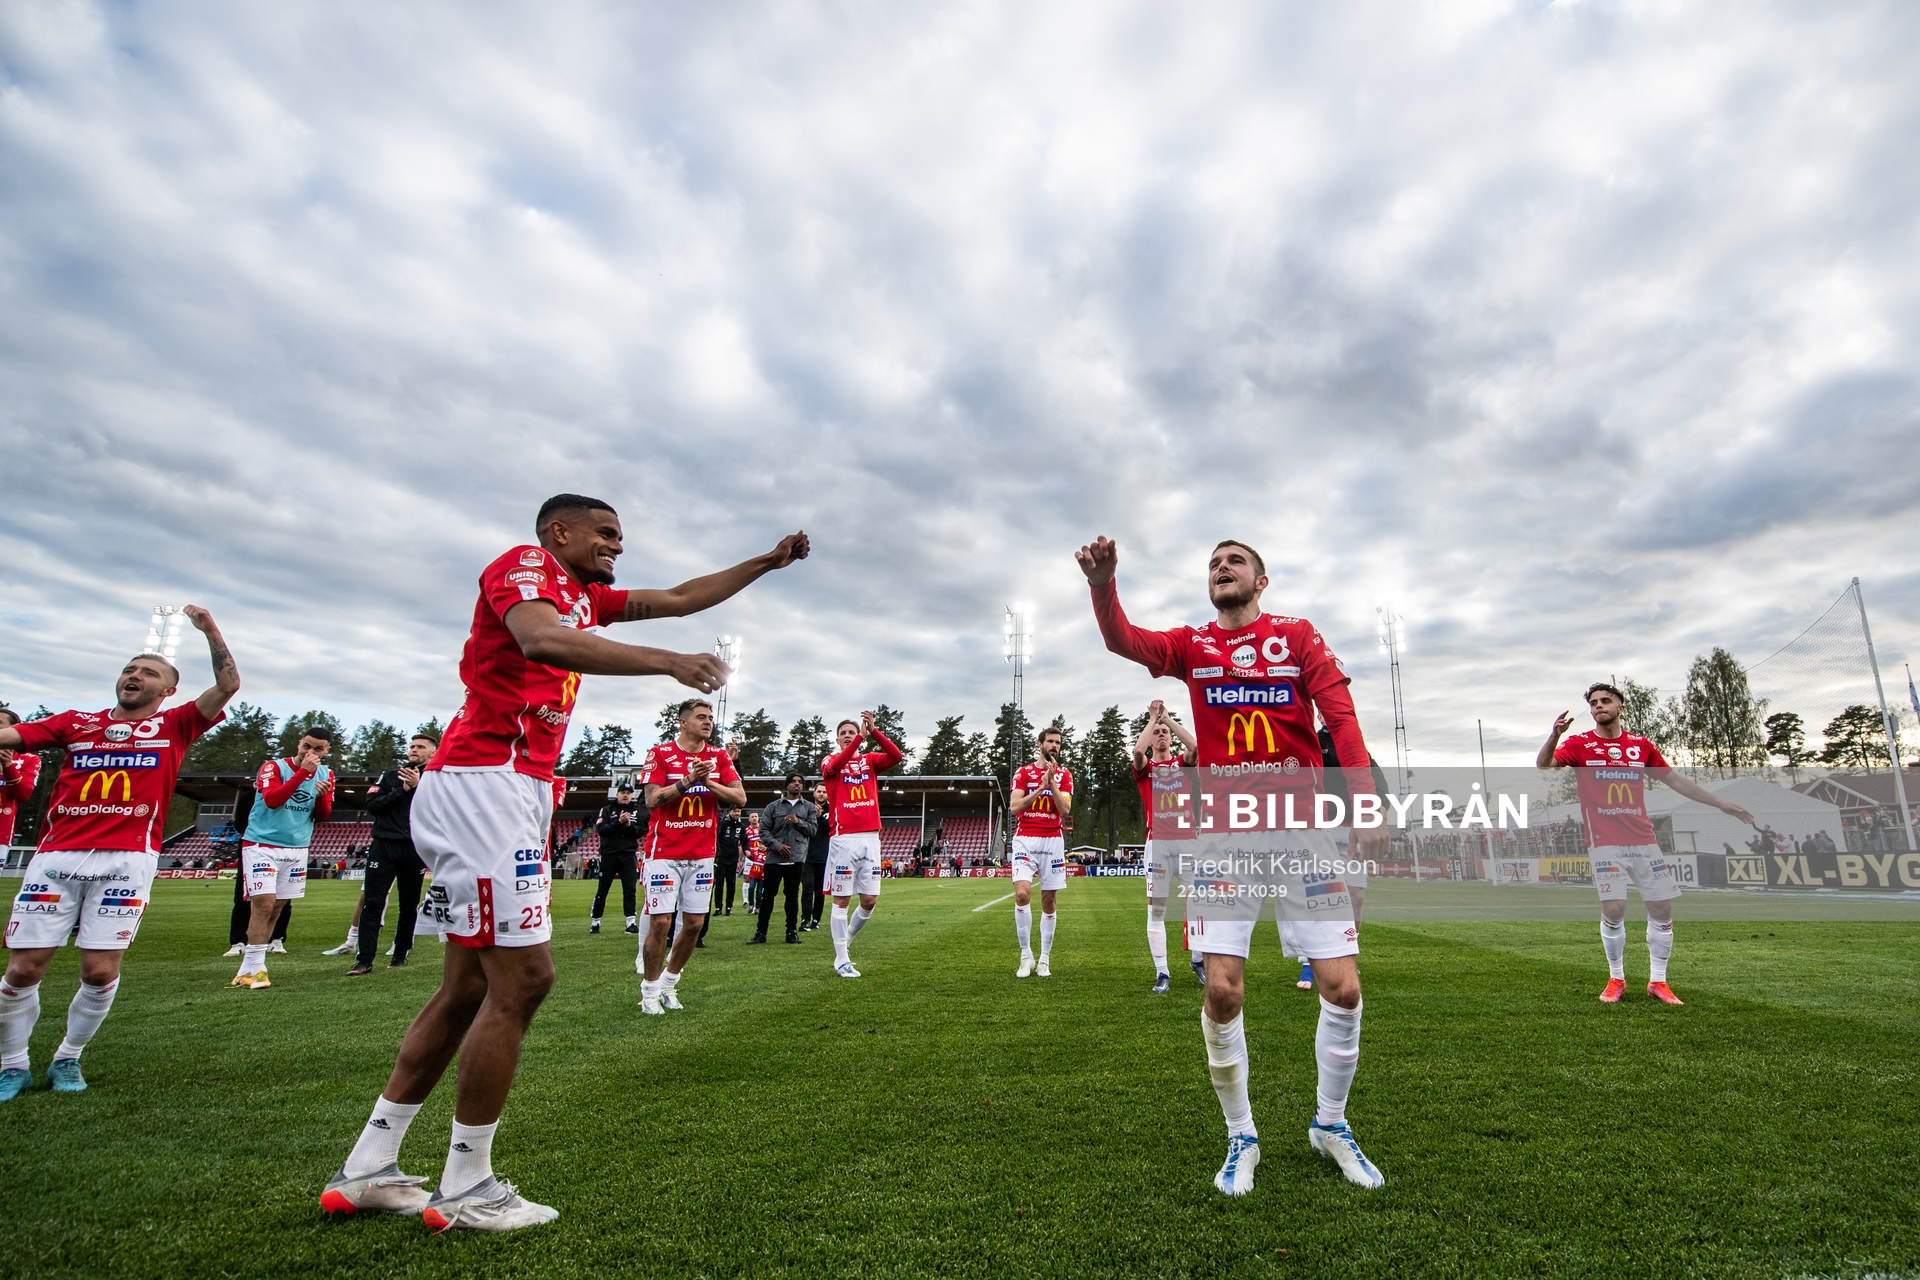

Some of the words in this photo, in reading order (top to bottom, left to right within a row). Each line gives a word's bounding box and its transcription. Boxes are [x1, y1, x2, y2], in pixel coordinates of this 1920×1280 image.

[509, 571, 545, 582] UNIBET
[1226, 632, 1256, 646] Helmia
[1206, 687, 1290, 704] Helmia
[73, 753, 157, 769] Helmia
[1211, 760, 1281, 778] ByggDialog
[1595, 769, 1639, 780] Helmia
[57, 803, 133, 816] ByggDialog
[1597, 807, 1638, 816] ByggDialog
[665, 820, 705, 829] ByggDialog
[1096, 866, 1146, 877] Helmia
[1302, 869, 1337, 884] CEOS
[1729, 859, 1764, 881] XL
[103, 888, 137, 898] CEOS
[1600, 883, 1612, 893] 22
[651, 897, 658, 907] 8
[1306, 895, 1351, 910] D-LAB
[519, 905, 543, 930] 23
